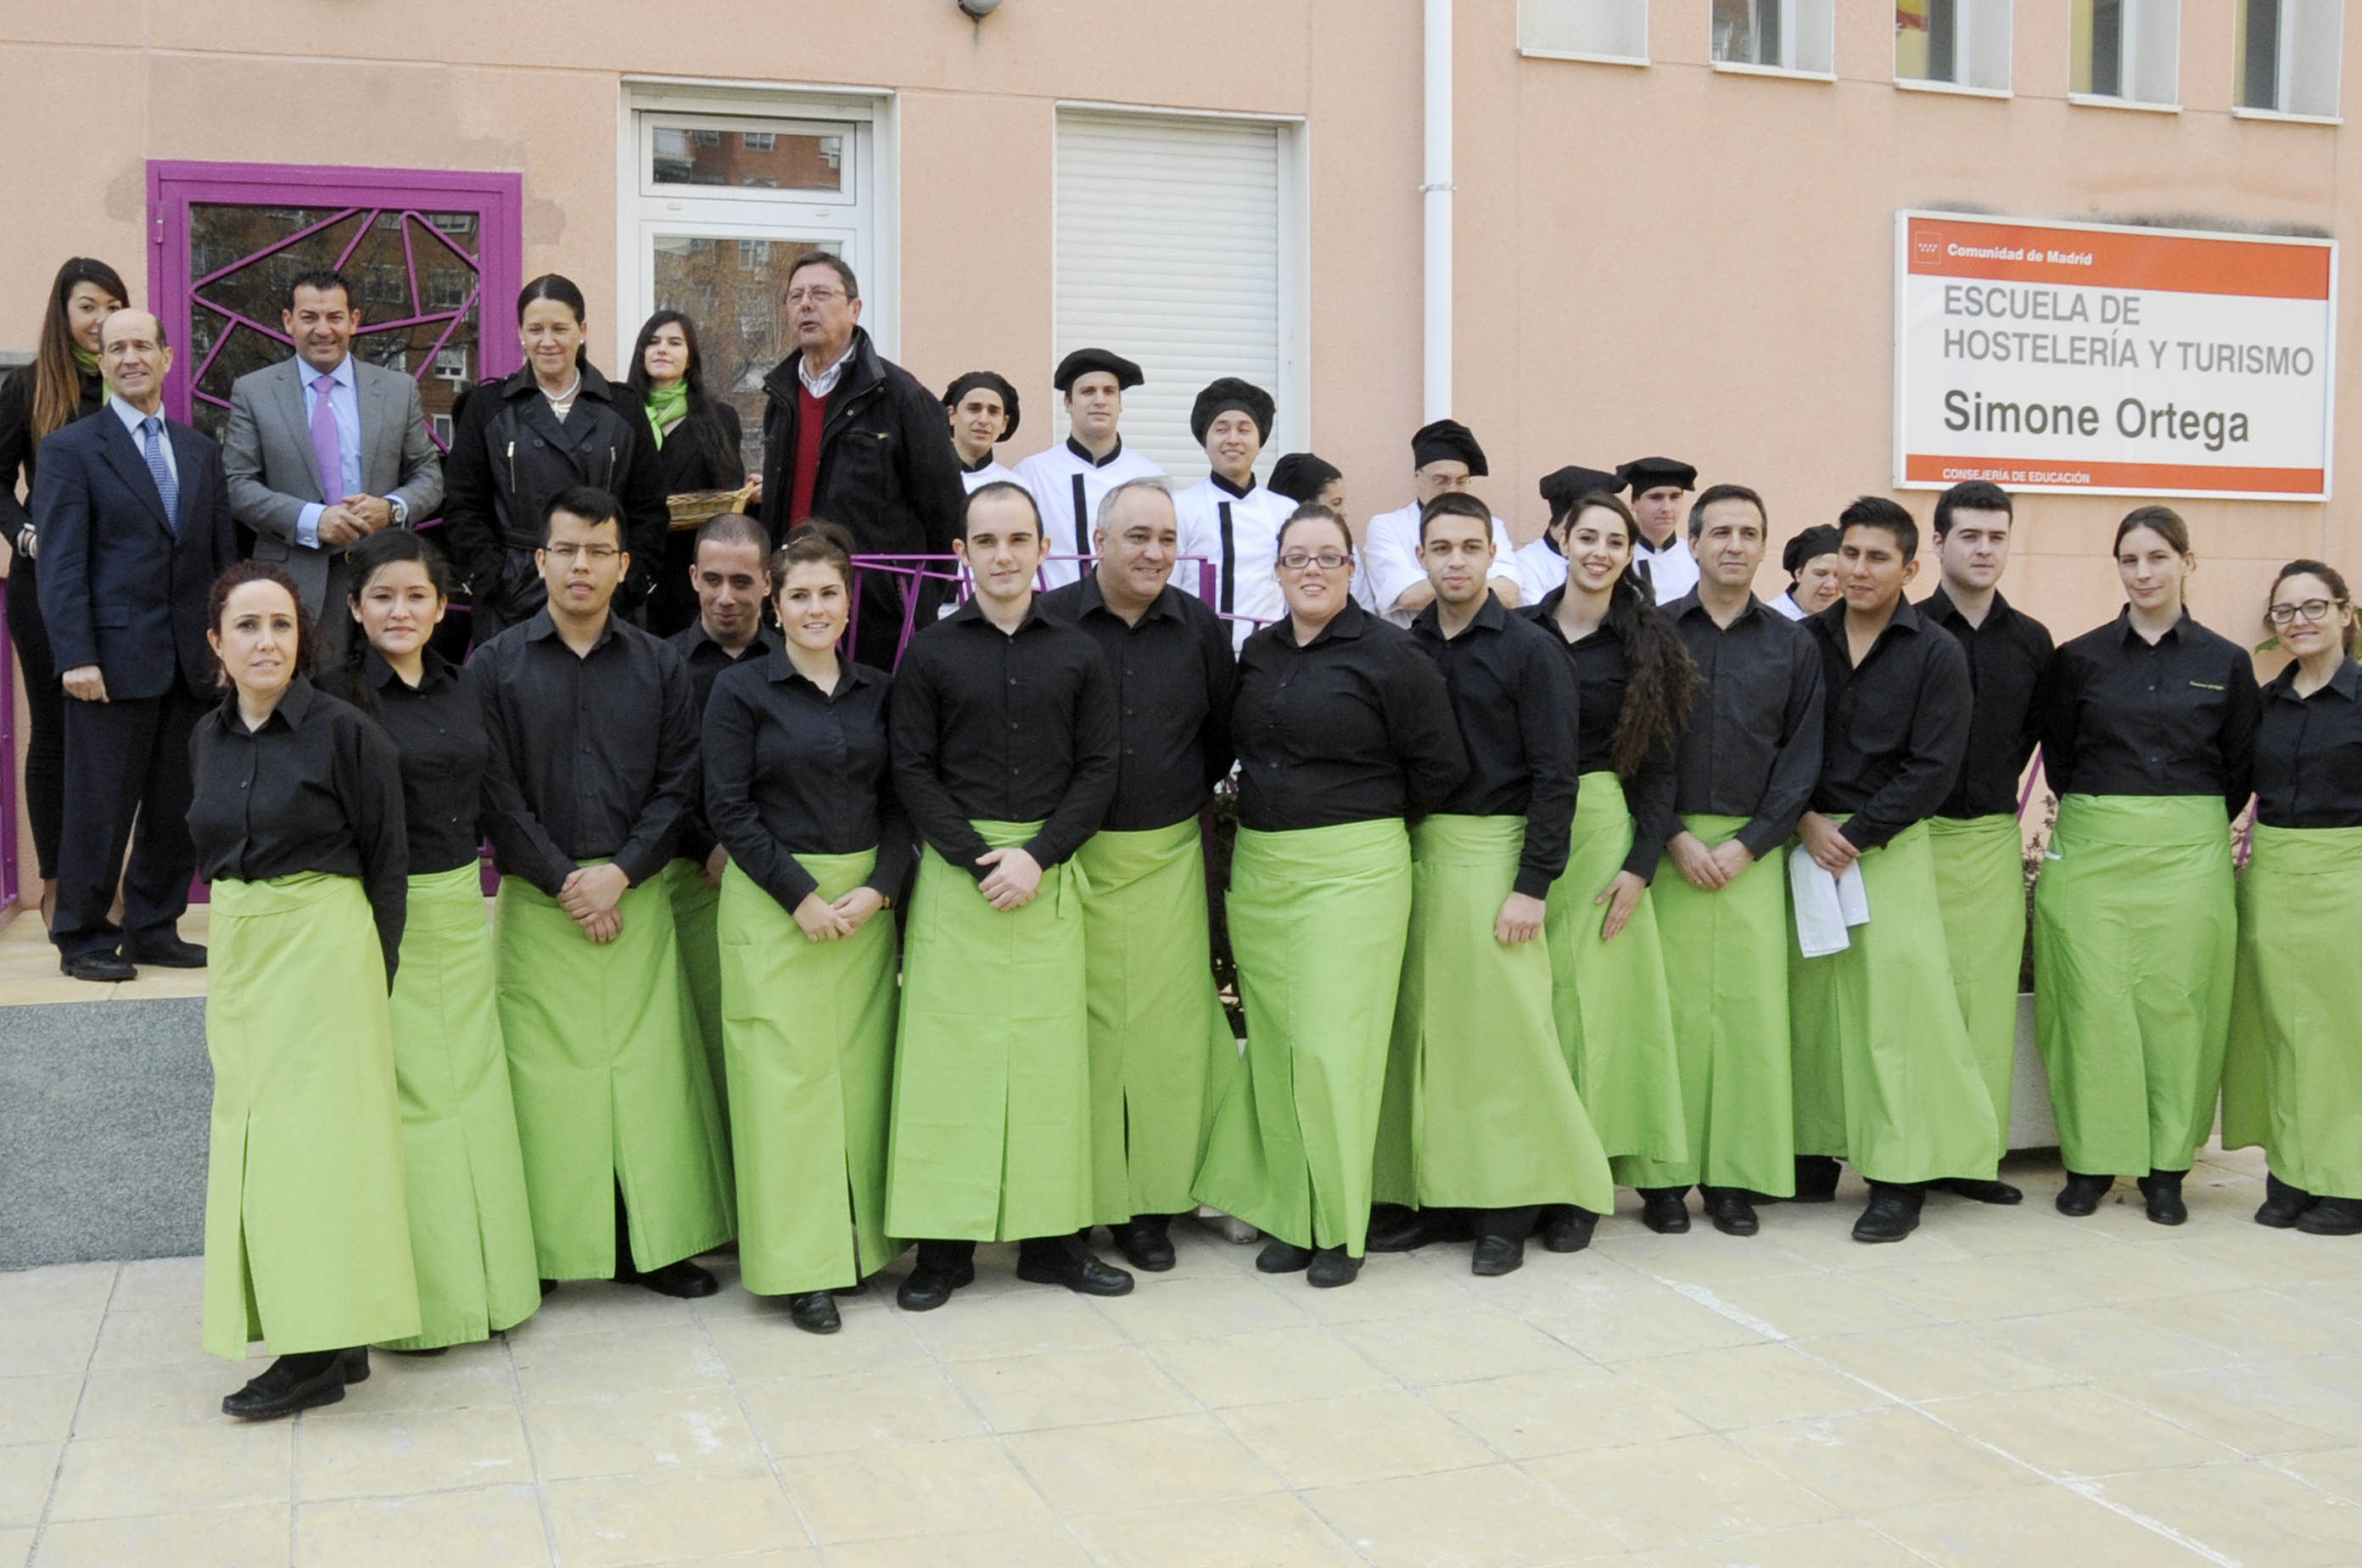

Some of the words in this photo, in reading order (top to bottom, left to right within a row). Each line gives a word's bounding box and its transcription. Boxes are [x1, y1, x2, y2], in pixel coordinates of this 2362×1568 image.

[1947, 243, 2023, 260] Comunidad
[2027, 248, 2044, 262] de
[2047, 249, 2092, 266] Madrid
[1945, 285, 2089, 322] ESCUELA
[2101, 295, 2141, 325] DE
[1945, 328, 2139, 368] HOSTELERÍA
[2149, 340, 2168, 369] Y
[2177, 342, 2314, 376] TURISMO
[1945, 390, 2099, 436] Simone
[2116, 398, 2249, 451] Ortega
[1943, 468, 2009, 482] CONSEJERÍA
[2012, 471, 2026, 482] DE
[2029, 470, 2091, 484] EDUCACIÓN
